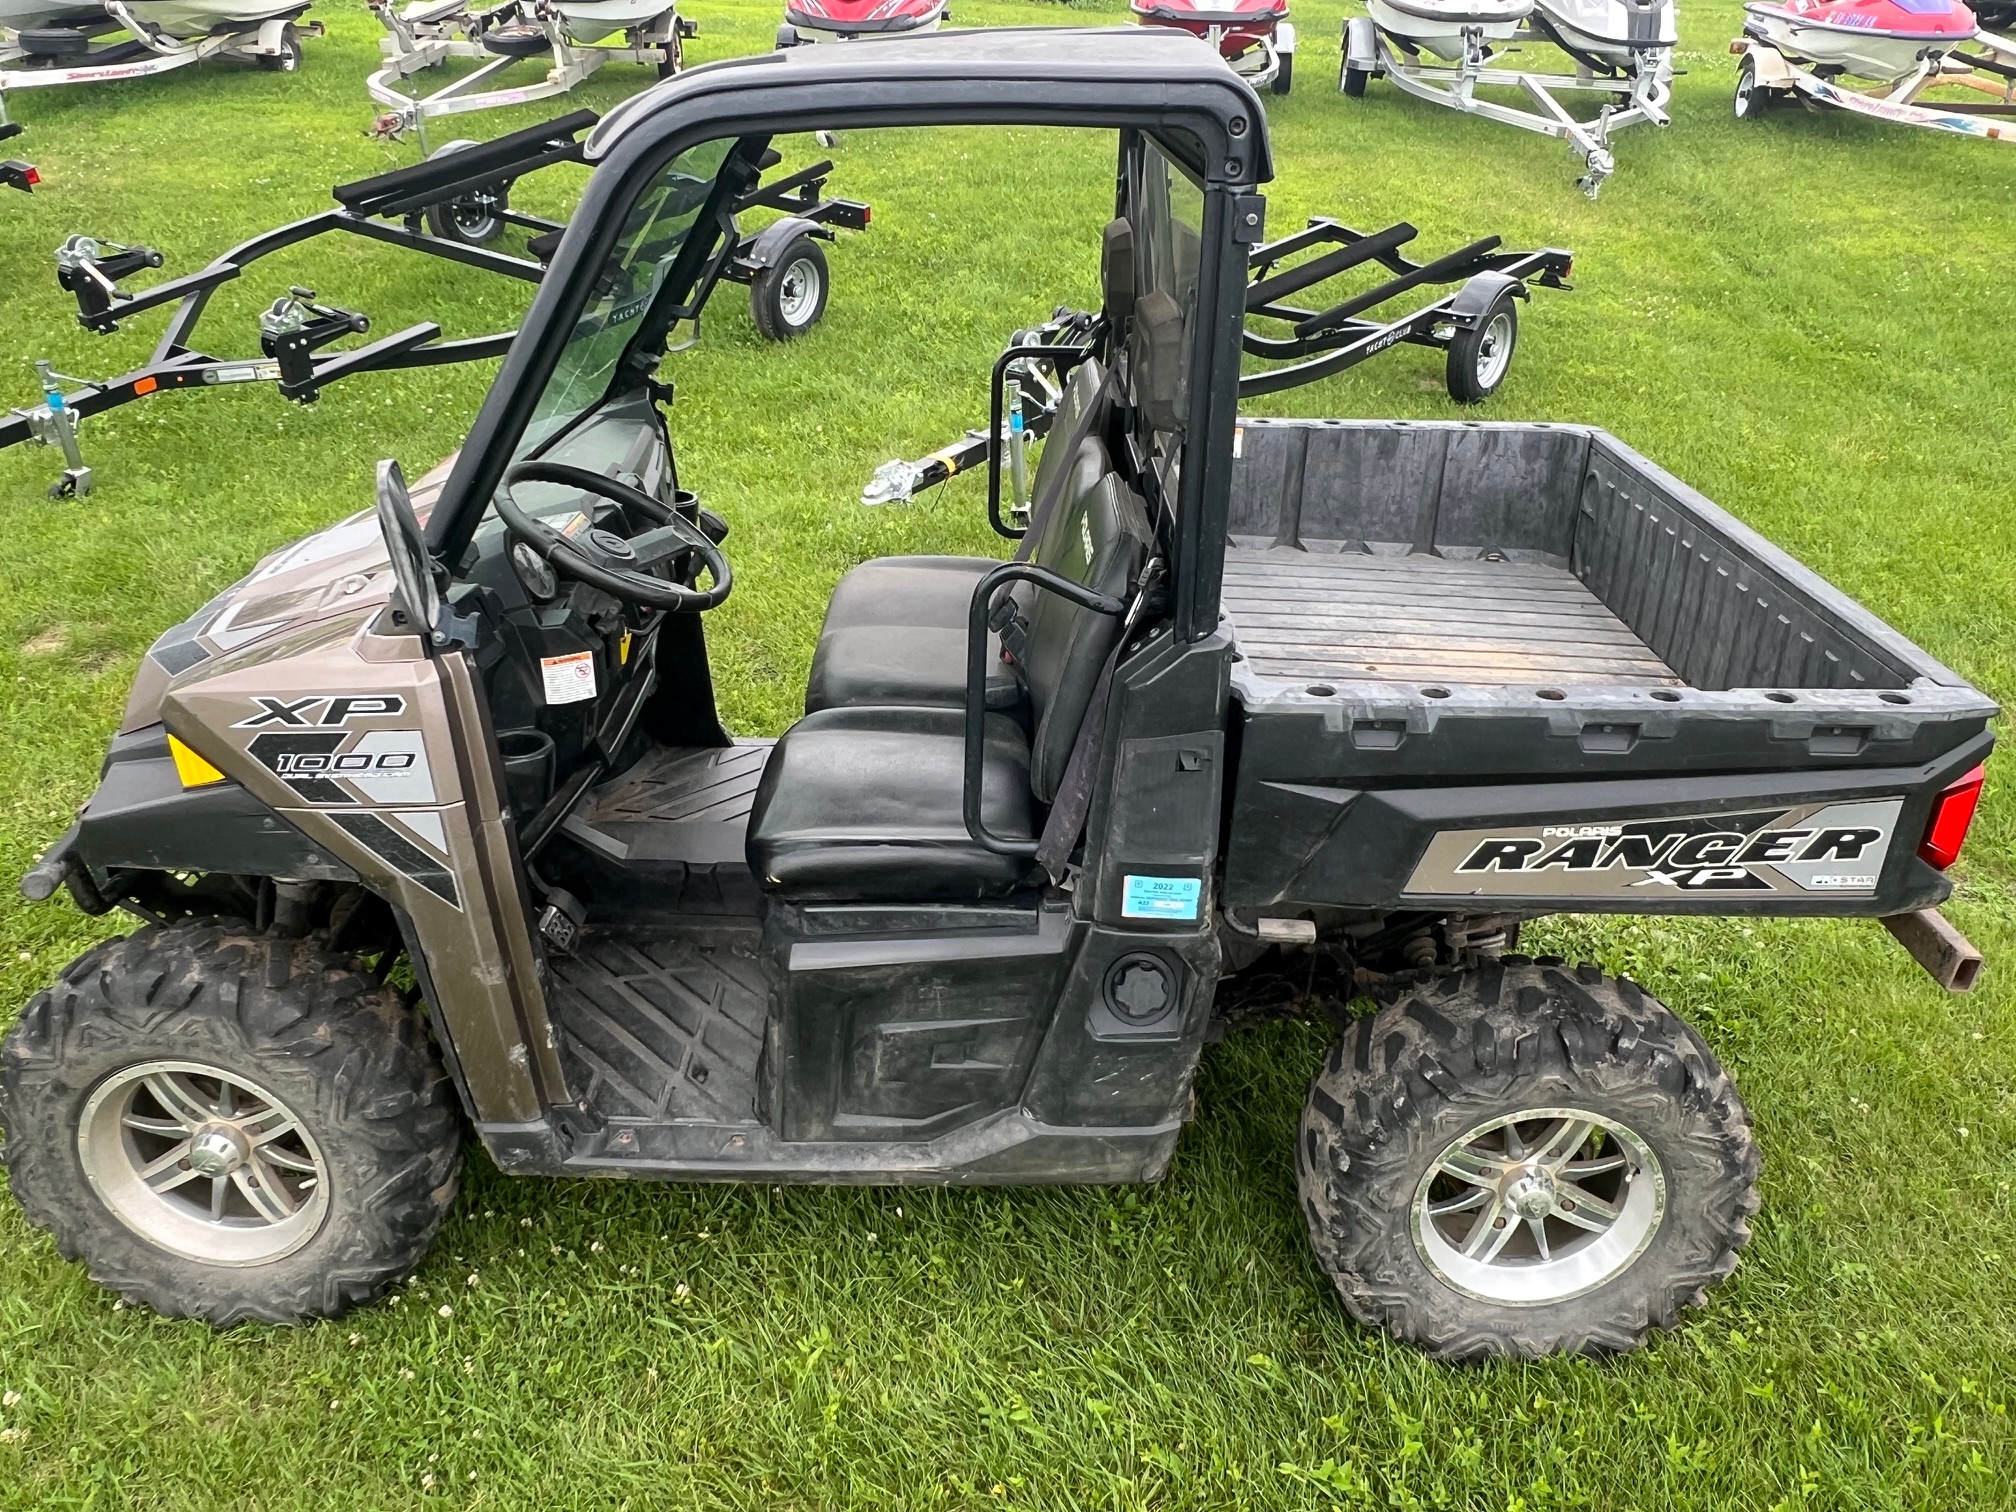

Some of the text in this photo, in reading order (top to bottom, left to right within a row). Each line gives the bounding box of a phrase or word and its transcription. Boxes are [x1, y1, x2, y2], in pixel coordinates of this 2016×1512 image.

[229, 694, 407, 729] XP
[276, 751, 417, 773] 1000
[1542, 826, 1623, 838] POLARIS
[1453, 826, 1884, 875] RANGER
[1153, 882, 1175, 891] 2022
[1622, 868, 1748, 887] XP
